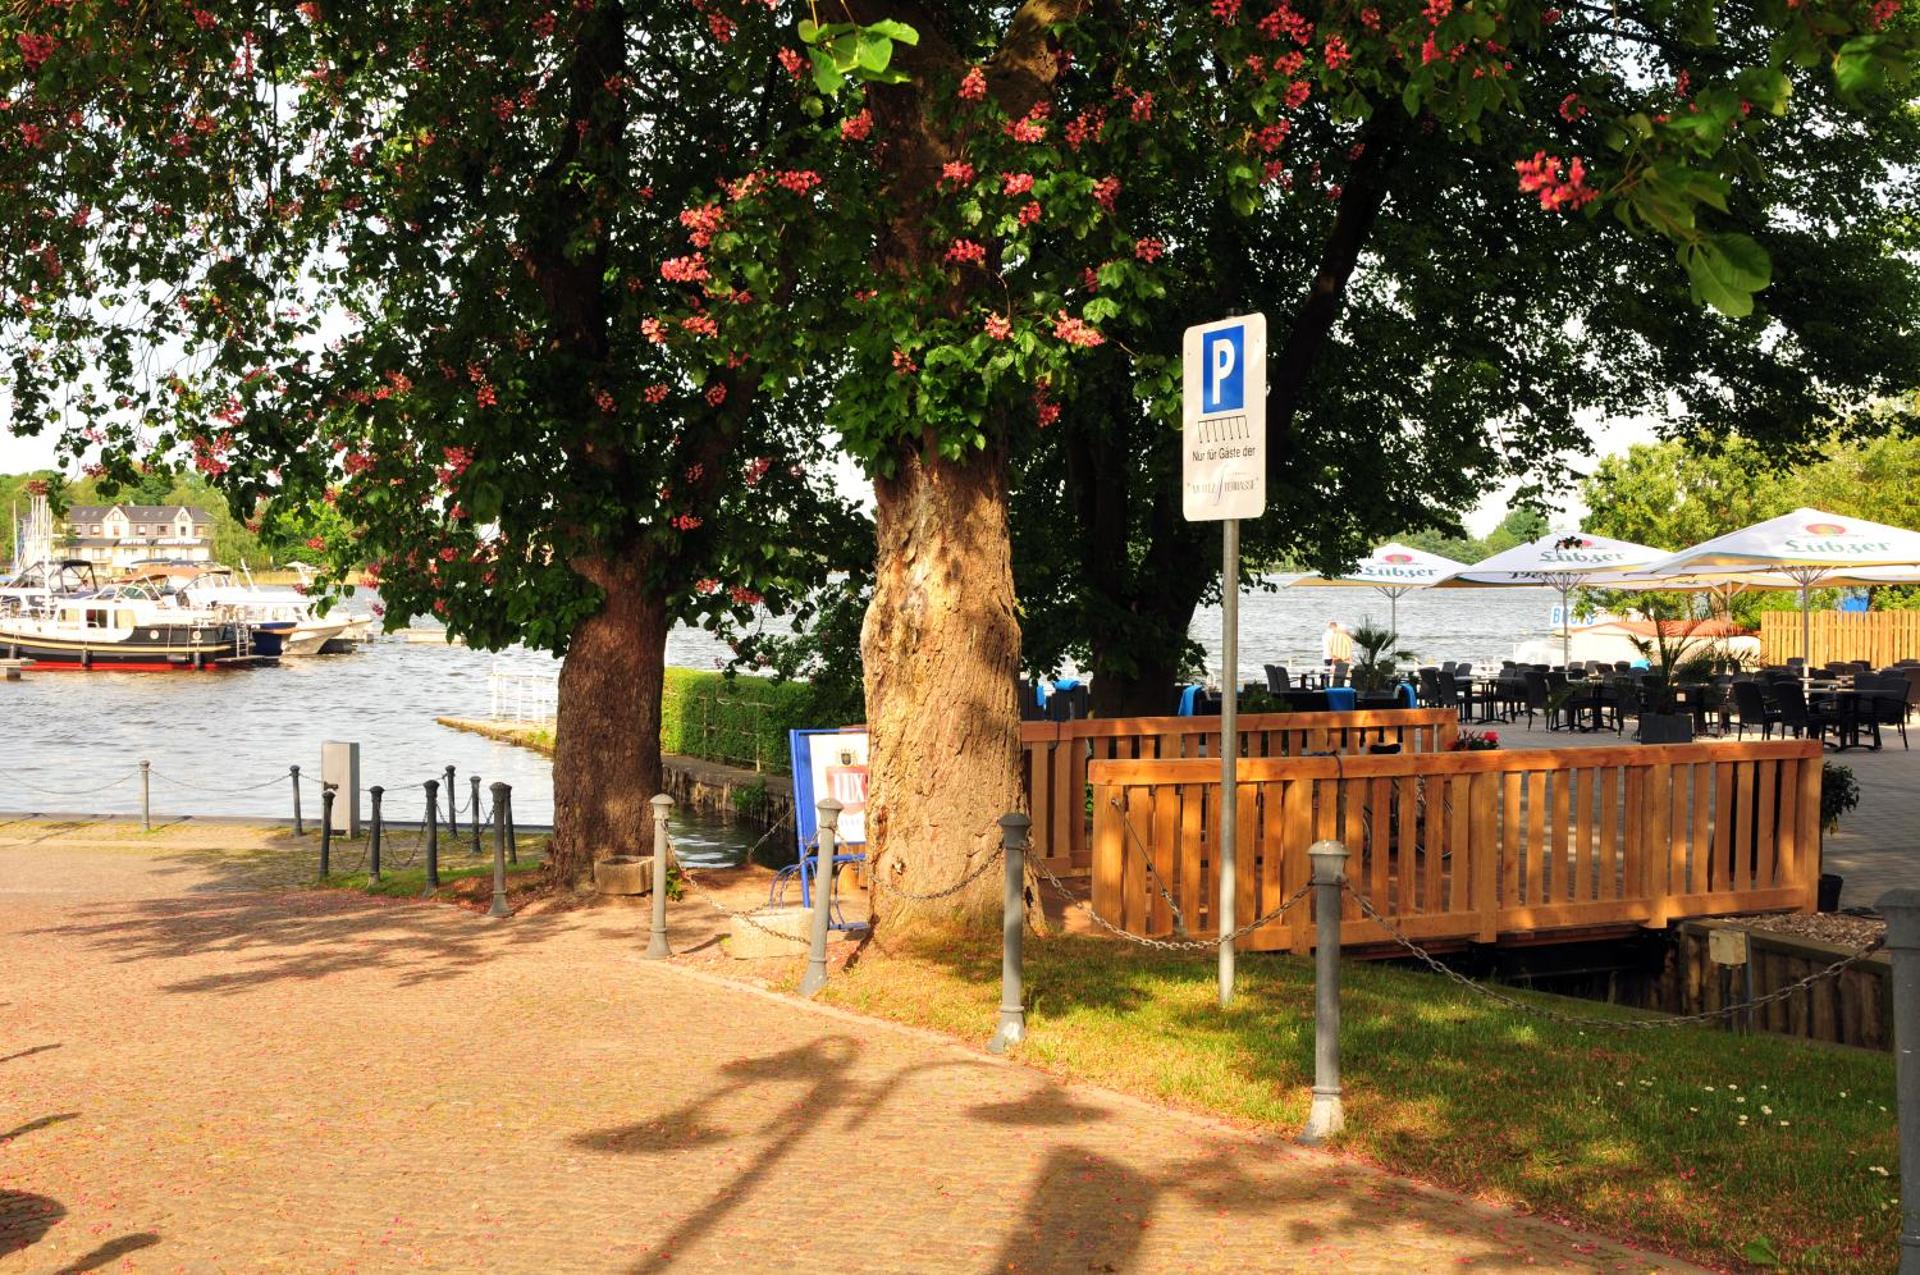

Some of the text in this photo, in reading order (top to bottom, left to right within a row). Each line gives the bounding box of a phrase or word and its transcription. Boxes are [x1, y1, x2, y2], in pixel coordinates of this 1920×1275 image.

[1212, 338, 1236, 405] P
[1192, 446, 1256, 462] Nur für Gäste der
